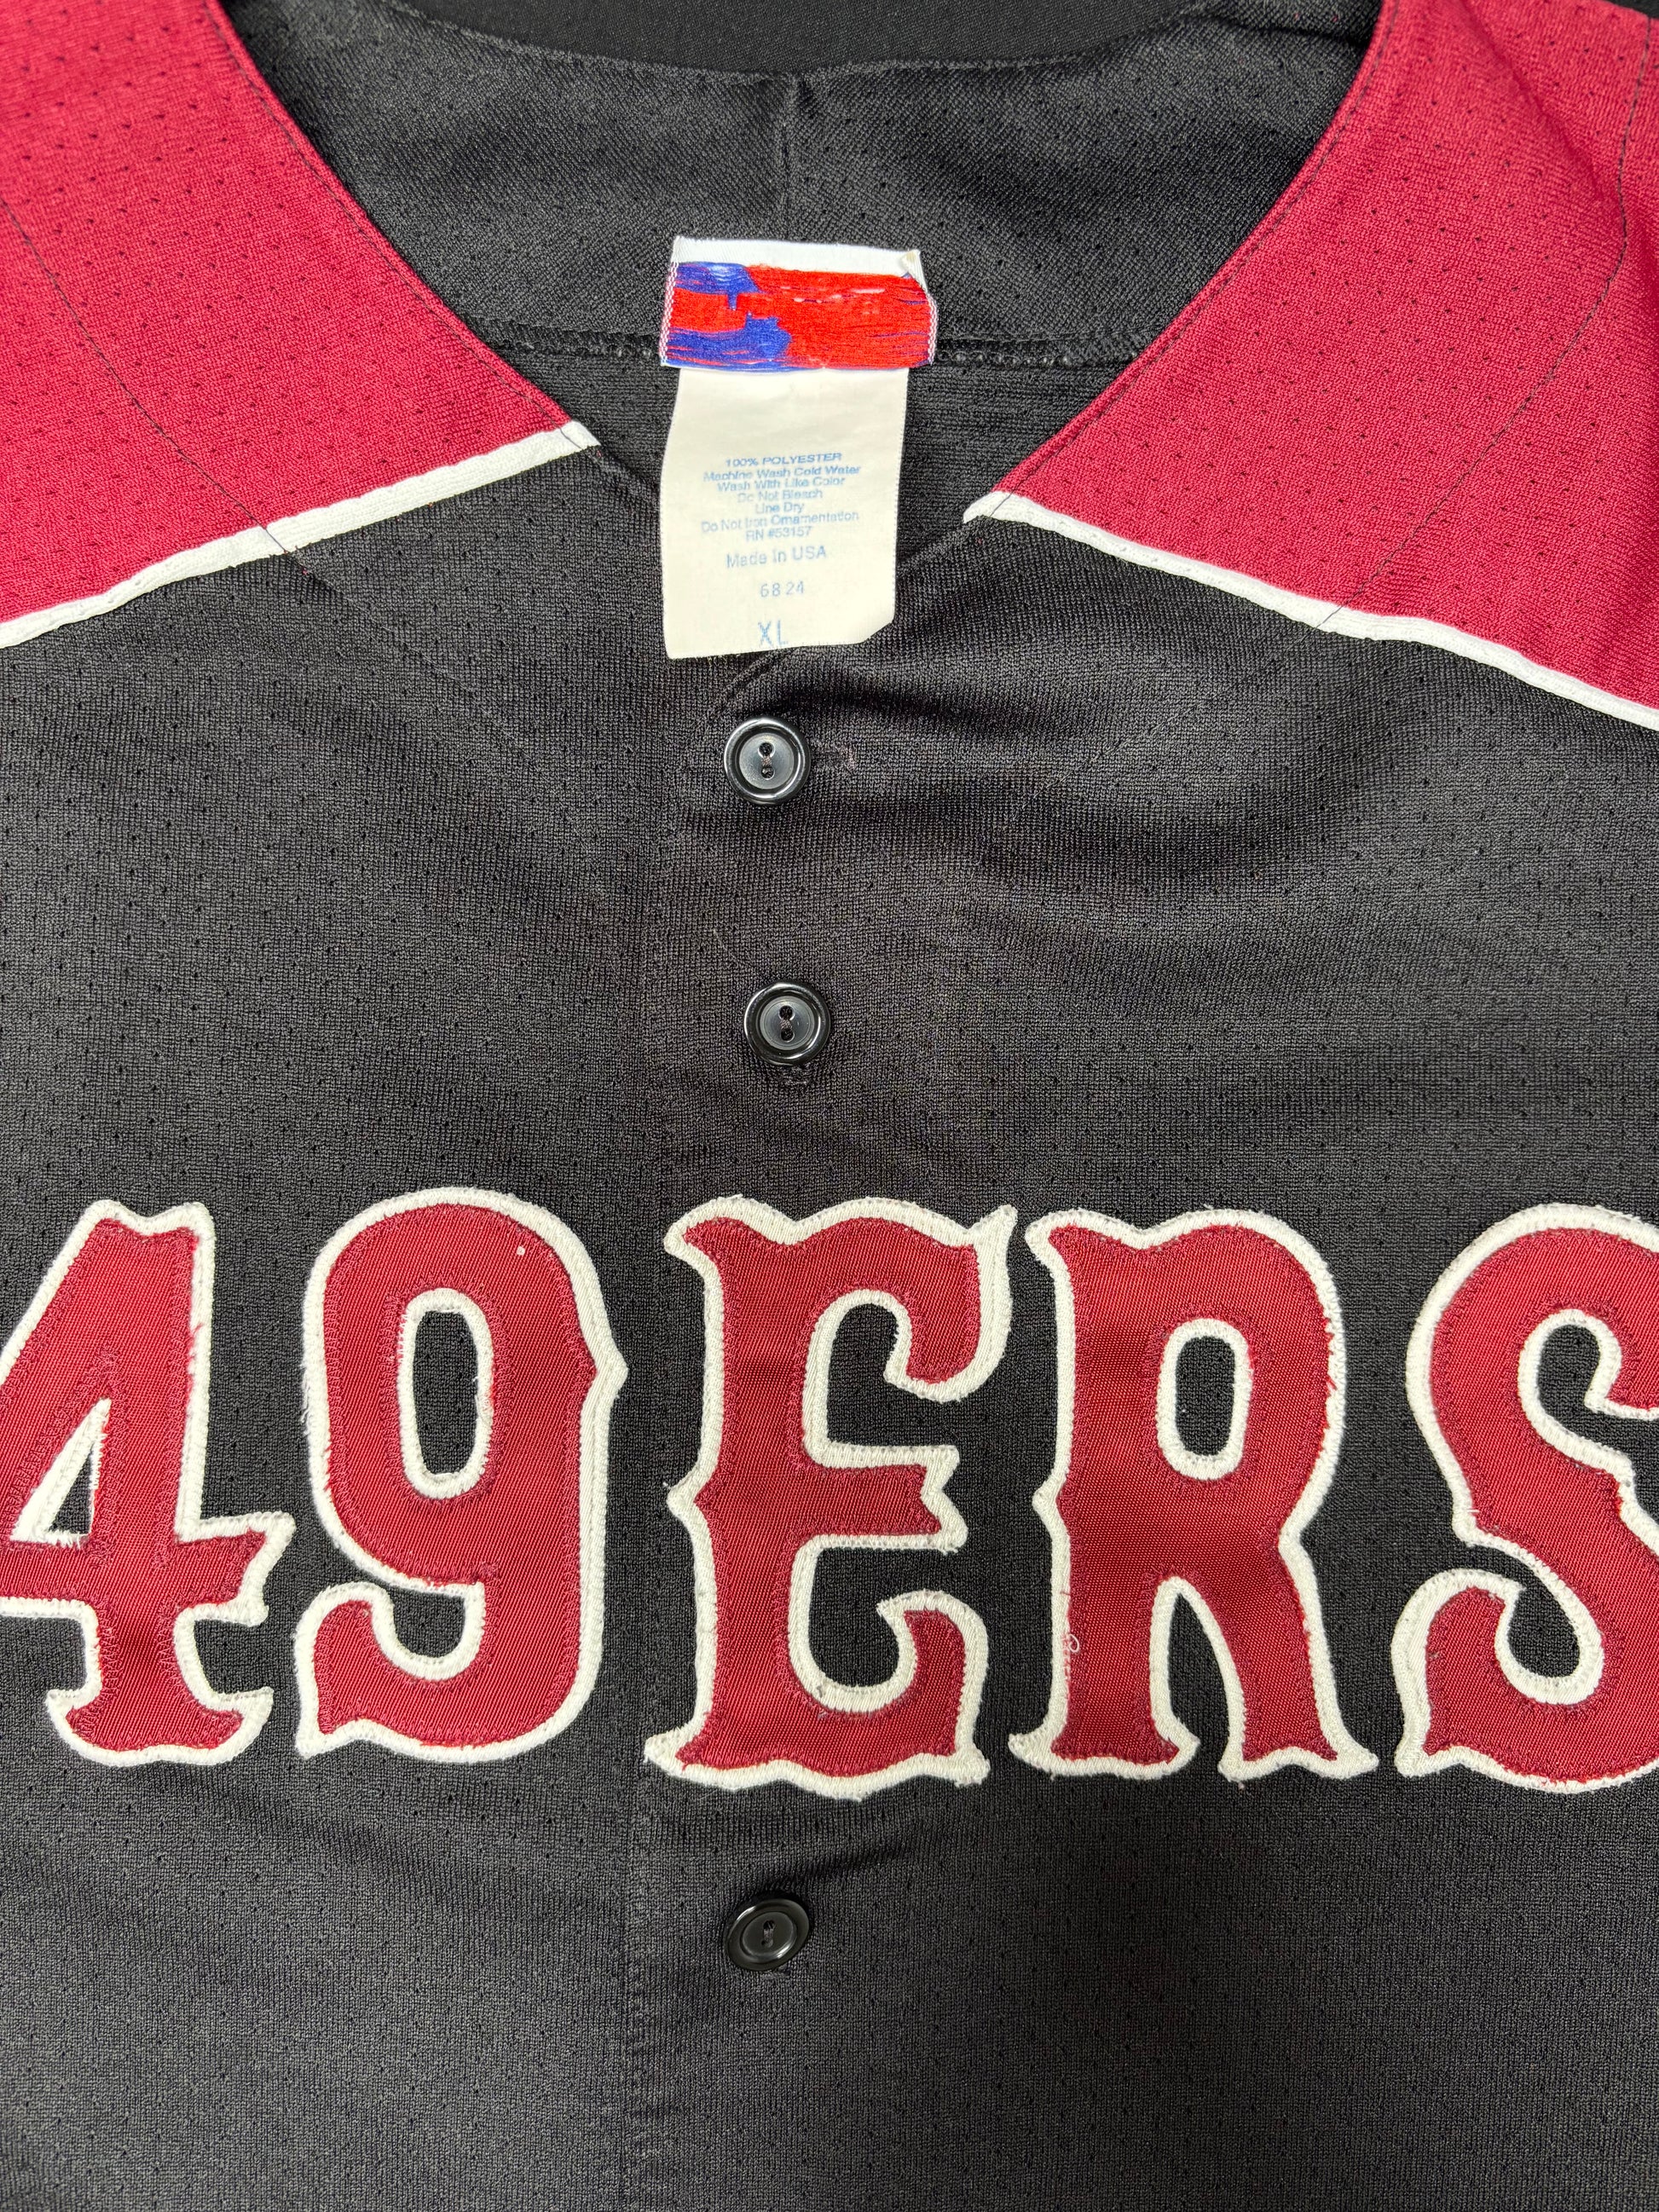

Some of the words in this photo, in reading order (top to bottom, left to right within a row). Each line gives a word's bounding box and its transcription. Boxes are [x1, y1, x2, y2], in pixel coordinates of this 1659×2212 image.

[725, 459, 758, 467] 100%
[762, 453, 842, 465] POLYESTER
[703, 471, 753, 482] Machine
[757, 468, 791, 478] Wash
[794, 466, 822, 476] Cold
[825, 465, 861, 474] Water
[717, 482, 750, 492] Wash
[755, 478, 781, 489] With
[784, 477, 809, 488] Like
[812, 476, 846, 486] Color
[737, 493, 754, 503] Do
[759, 490, 779, 501] Not
[783, 488, 823, 500] Bleach
[755, 504, 780, 514] Line
[783, 501, 805, 513] Dry
[701, 521, 719, 533] Do
[721, 518, 743, 530] Not
[745, 516, 767, 528] Iron
[771, 511, 859, 525] Ornamentation
[745, 528, 765, 541] RN
[767, 526, 812, 539] #53157
[726, 552, 767, 569] Made
[792, 546, 827, 561] USA
[757, 620, 789, 646] XL
[0, 1186, 1659, 1800] 49ERS
